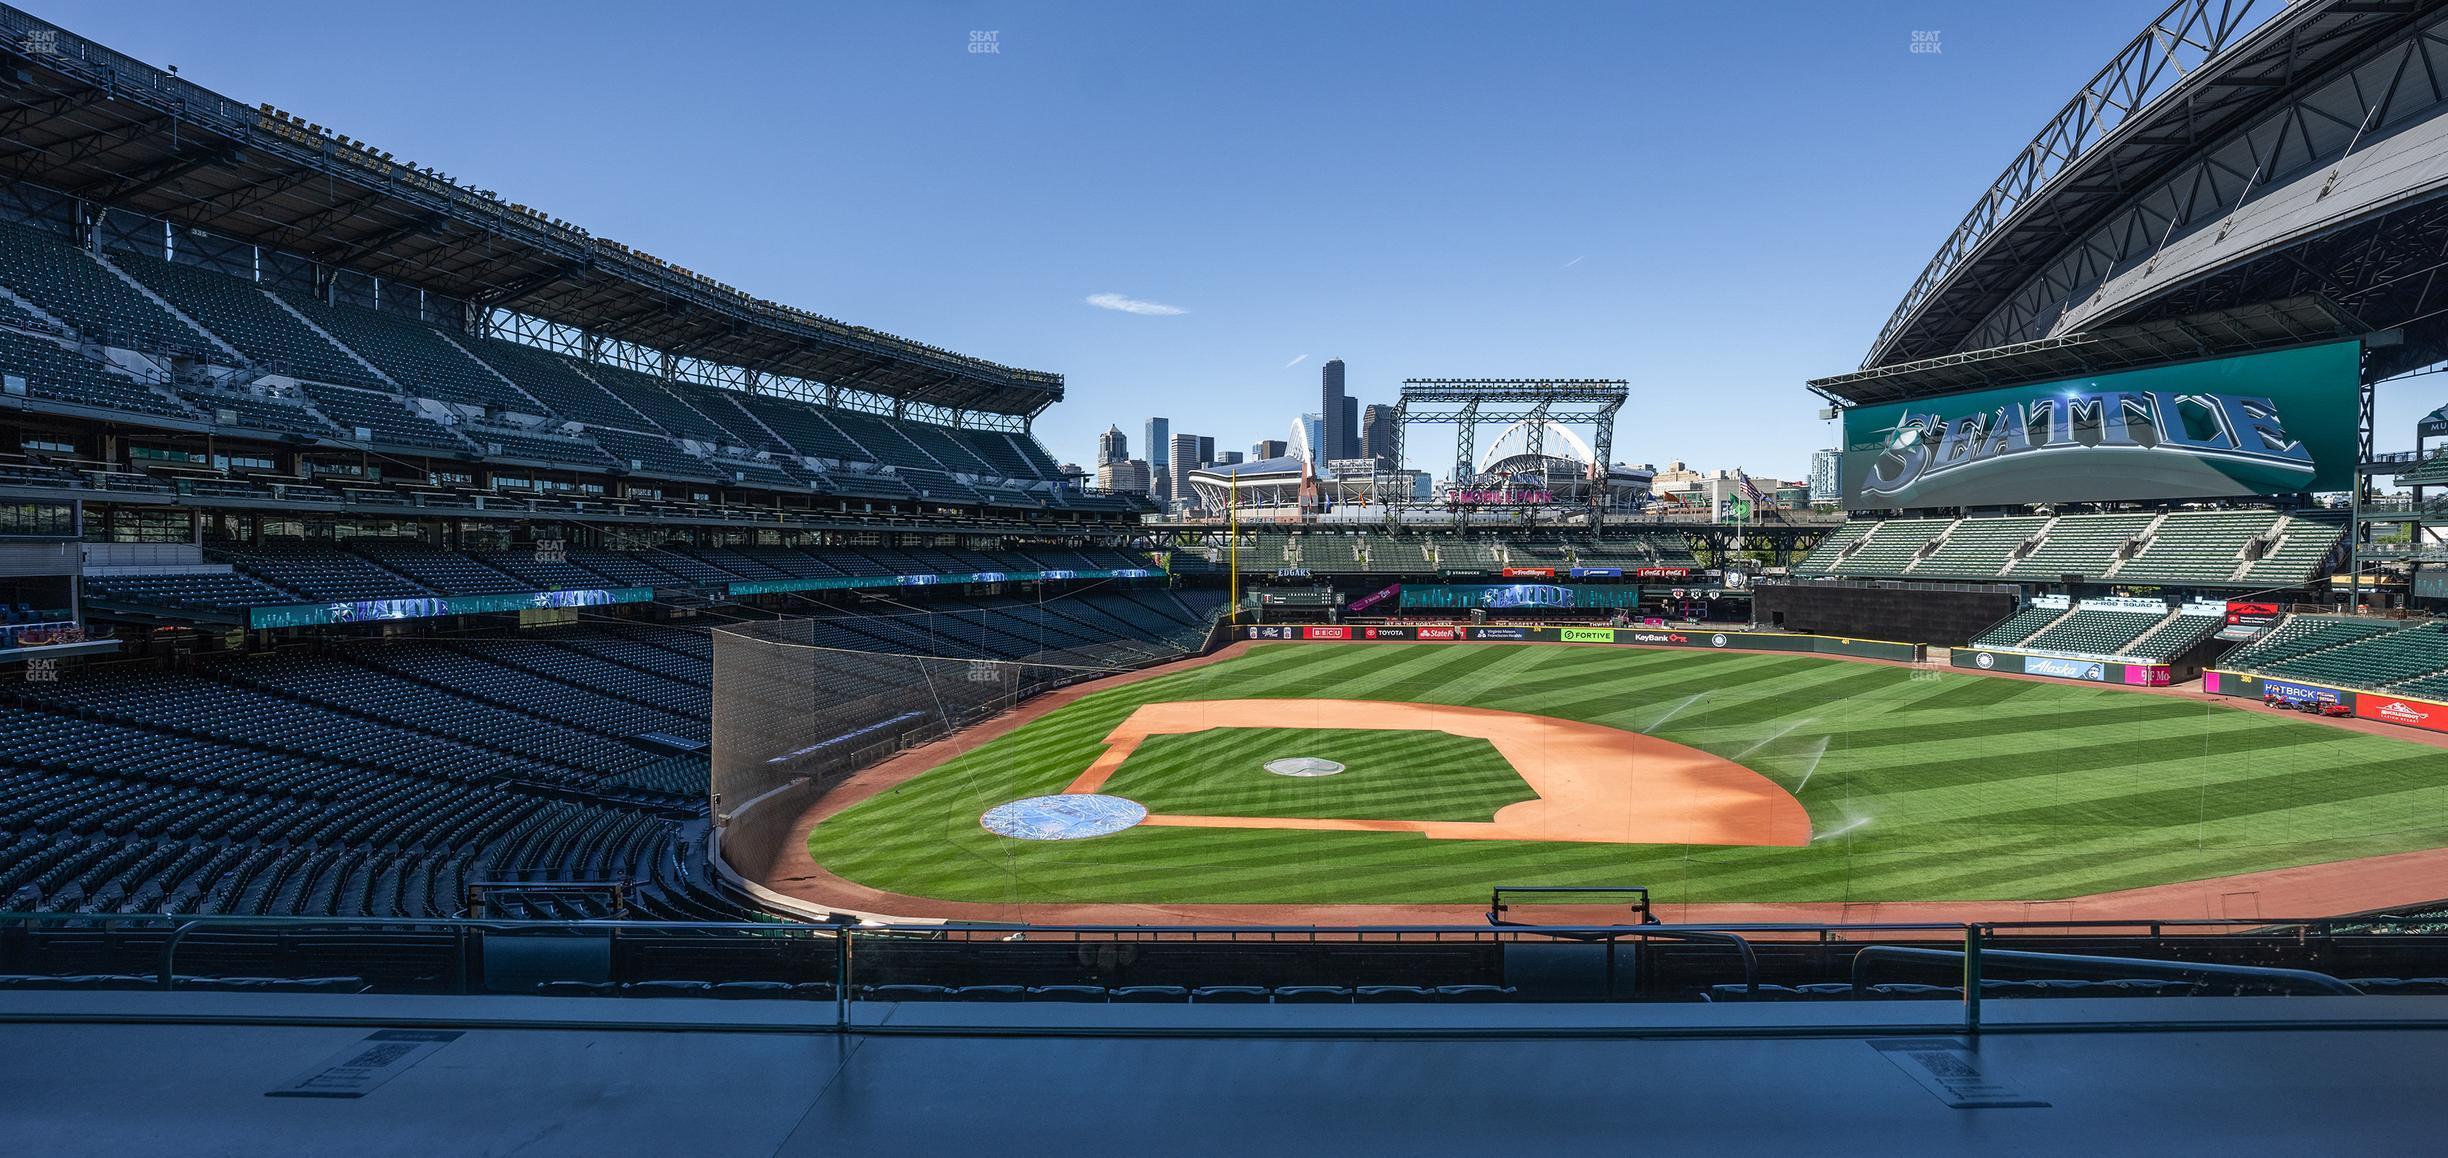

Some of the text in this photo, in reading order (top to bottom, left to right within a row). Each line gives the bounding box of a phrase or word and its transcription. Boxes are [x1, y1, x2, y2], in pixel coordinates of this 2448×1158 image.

[1861, 391, 2315, 496] SEATTLE
[1516, 490, 1553, 503] PARK
[1575, 631, 1611, 640] FORTIVE
[1635, 633, 1669, 642] KeyBank
[2028, 662, 2076, 676] Alaska
